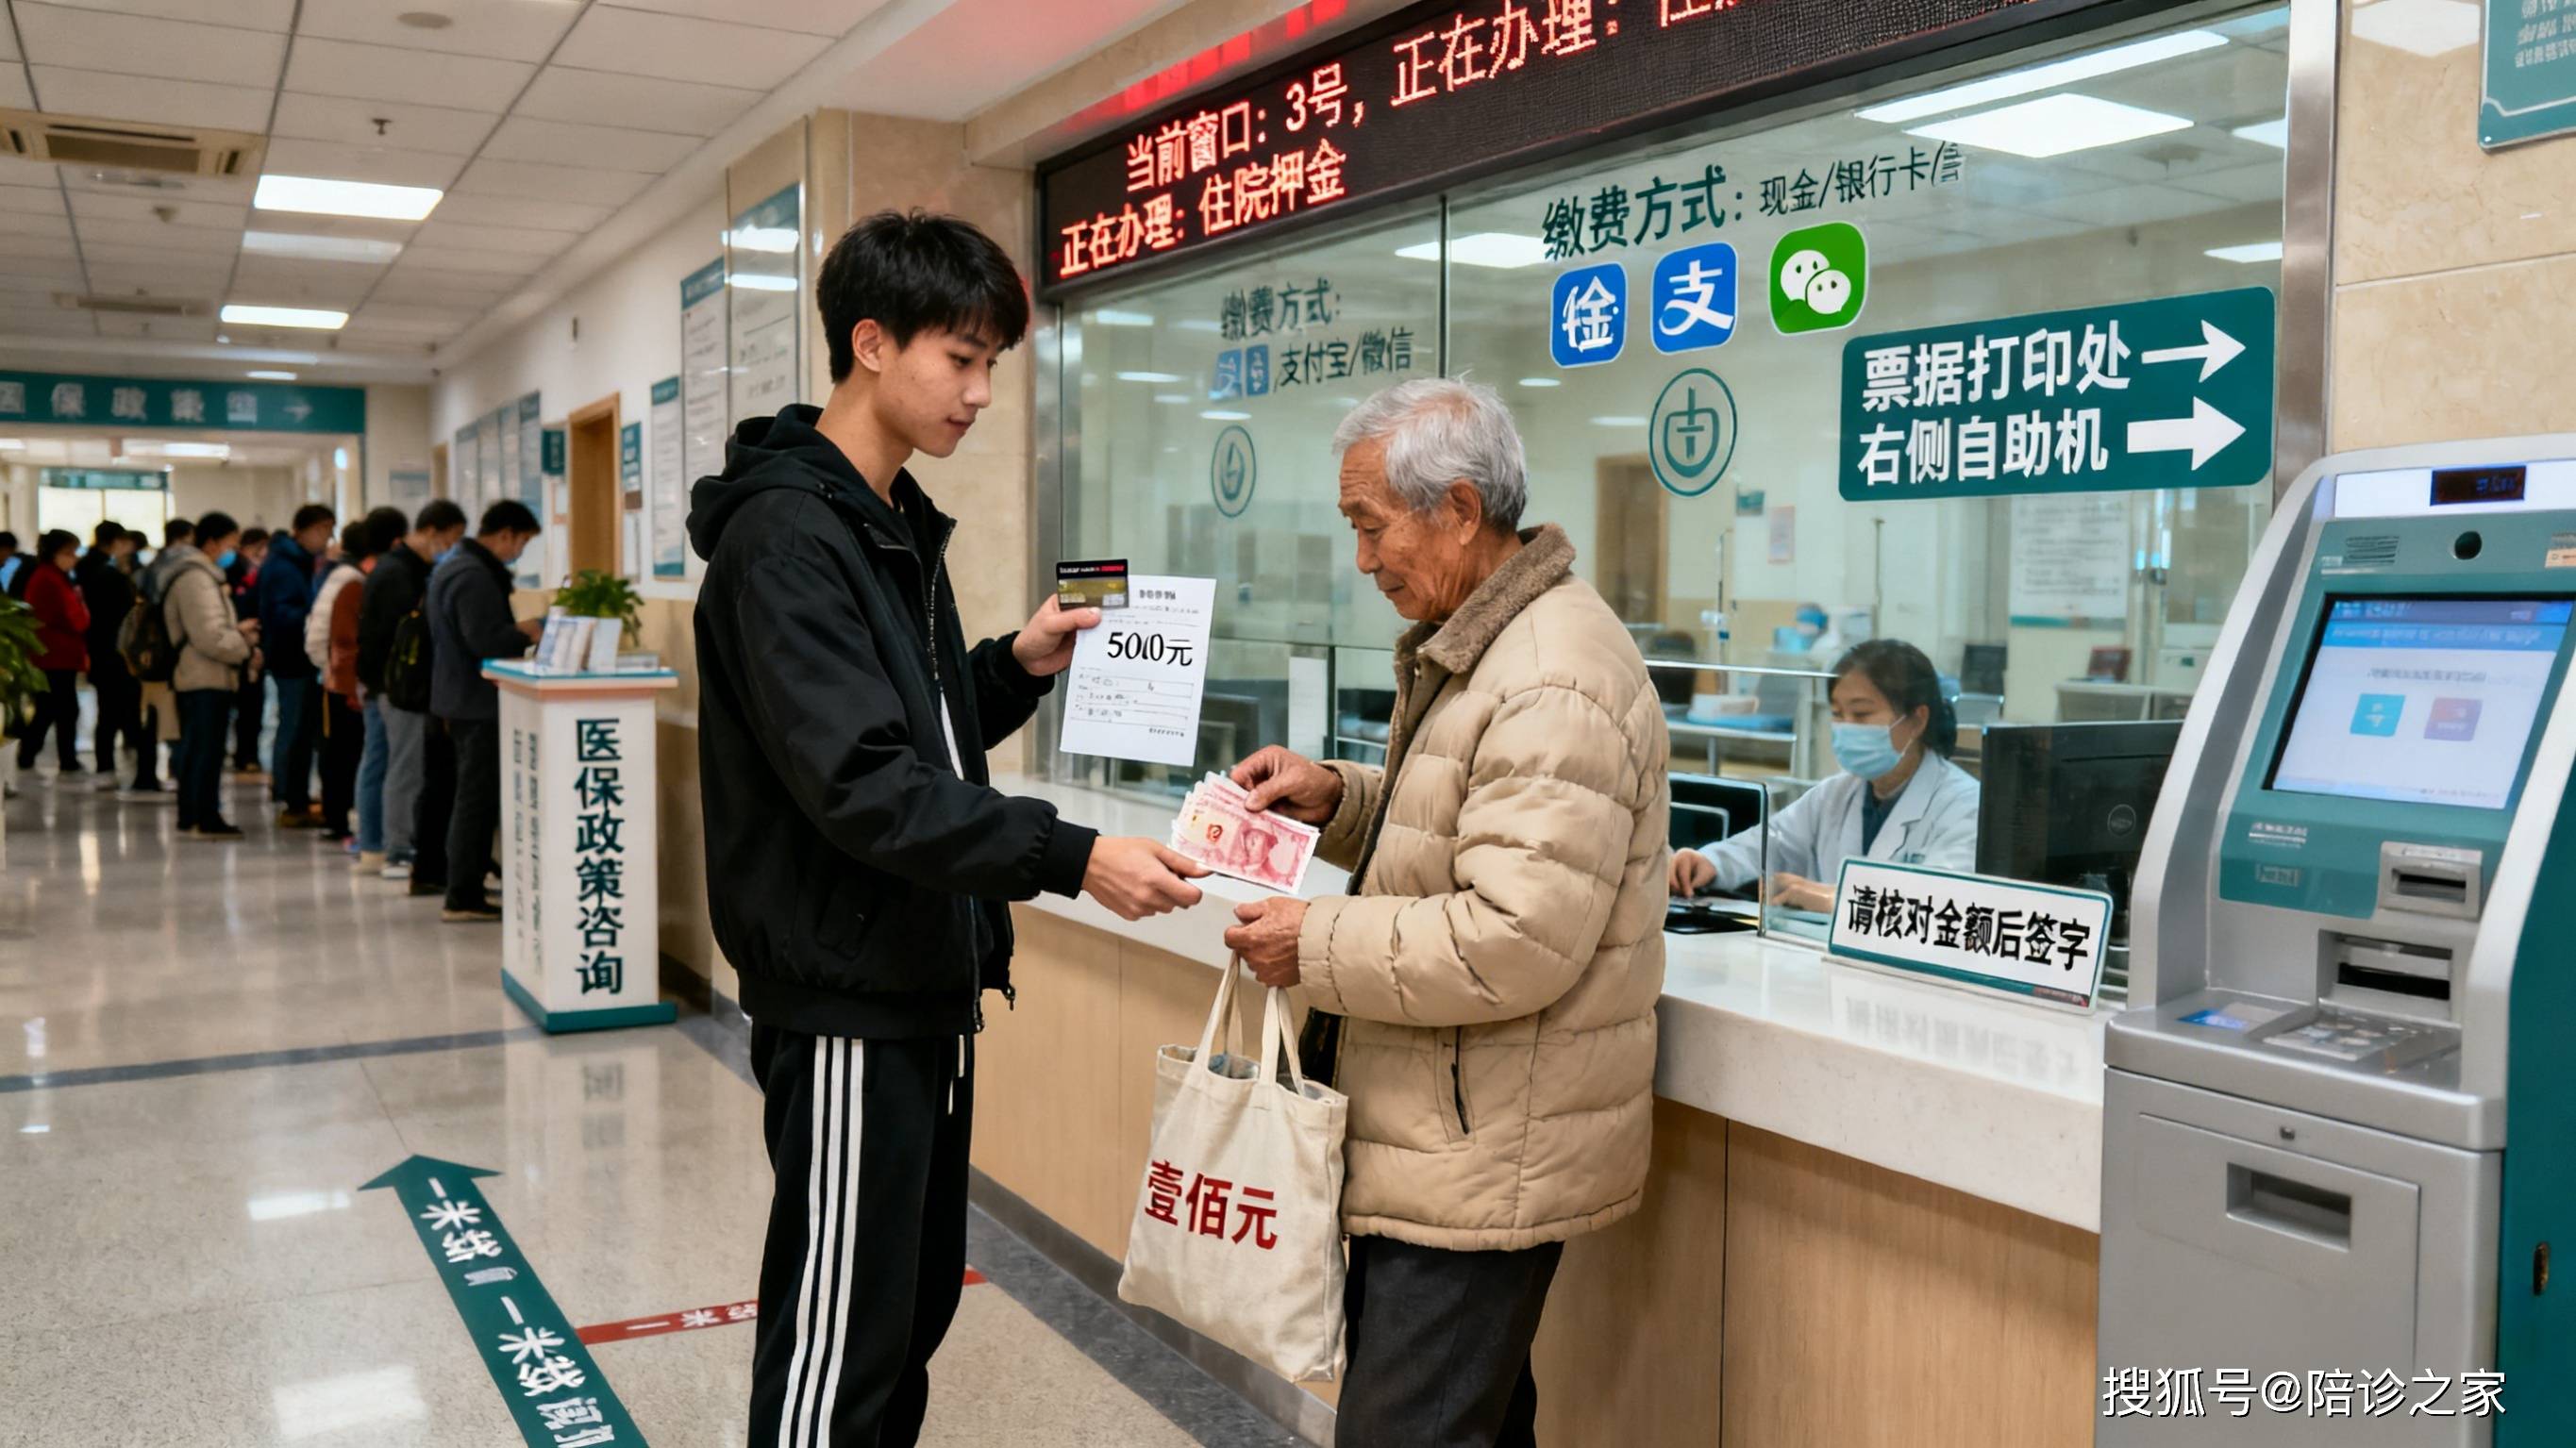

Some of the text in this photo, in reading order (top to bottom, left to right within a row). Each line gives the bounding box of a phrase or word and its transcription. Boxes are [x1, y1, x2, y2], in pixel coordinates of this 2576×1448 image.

[1862, 320, 2132, 412] 票据打印处
[1857, 408, 2109, 486] 右侧自助机
[573, 717, 625, 995] 医保政策咨询
[1848, 885, 2091, 972] 请核对金额后签字
[1145, 1159, 1278, 1250] 壹佰元
